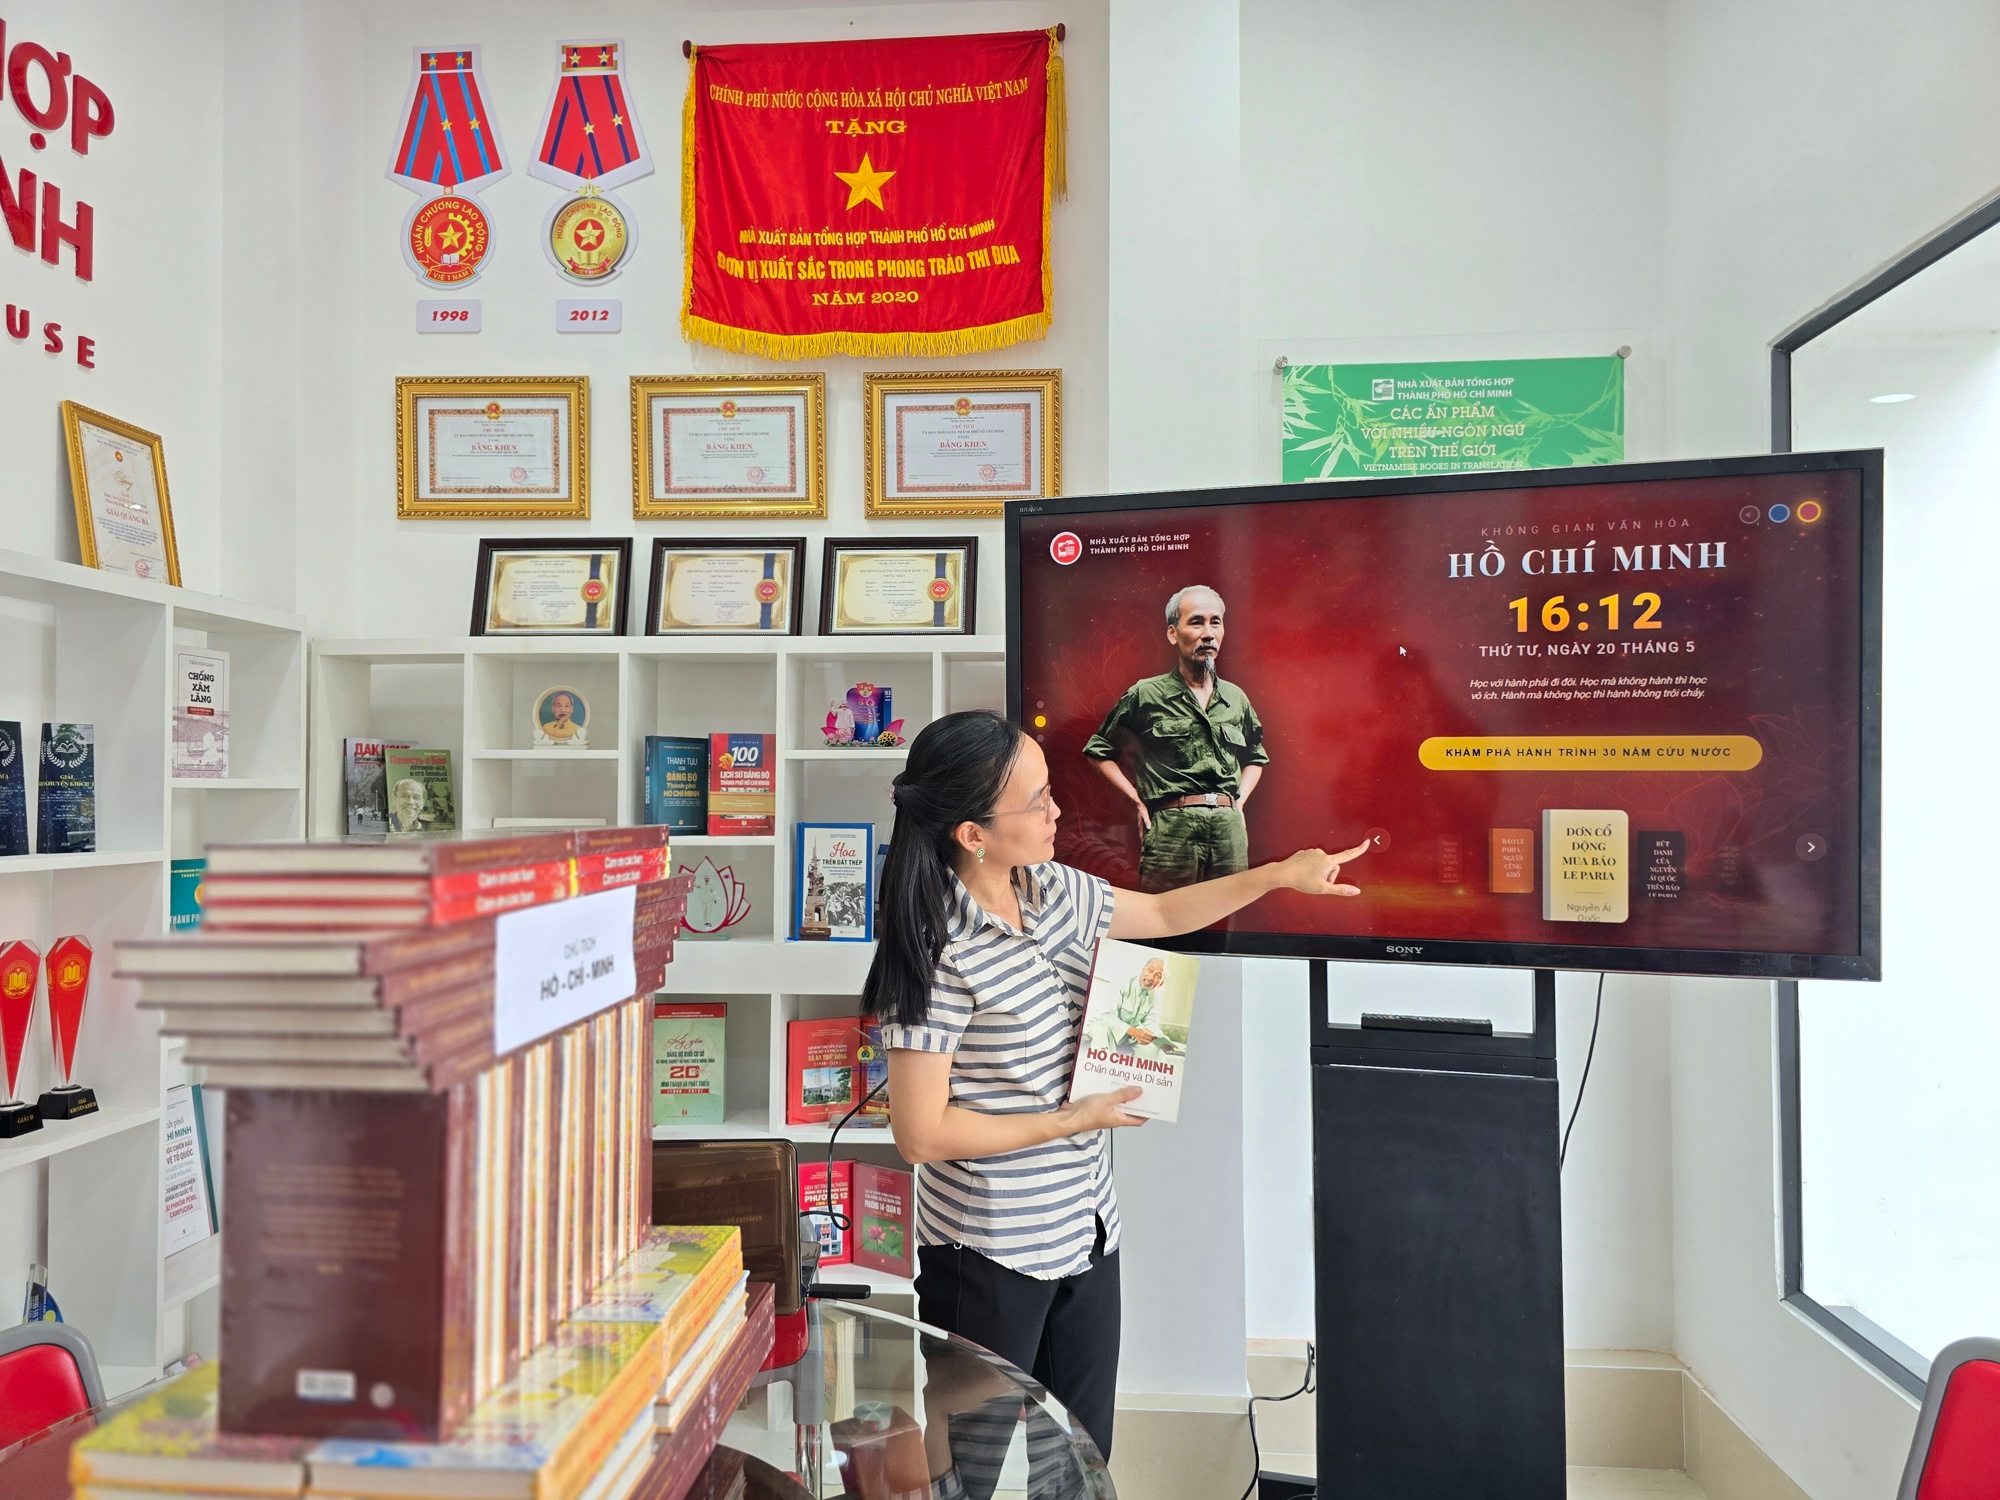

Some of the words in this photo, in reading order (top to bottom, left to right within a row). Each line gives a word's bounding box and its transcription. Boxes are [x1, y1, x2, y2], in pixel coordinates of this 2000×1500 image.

[0, 18, 115, 155] ỢP
[710, 84, 743, 105] CHÍNH
[746, 87, 769, 108] PHỦ
[772, 89, 803, 108] NƯỚC
[807, 88, 838, 112] CỘNG
[841, 87, 865, 108] HÒA
[885, 87, 906, 111] HỘI
[909, 84, 933, 106] CHỦ
[936, 83, 974, 105] NGHĨA
[975, 81, 1002, 104] VIỆT
[1005, 77, 1028, 98] NAM
[826, 118, 907, 137] TẶNG
[461, 204, 479, 220] LAO
[599, 206, 613, 216] LAO
[739, 225, 756, 244] NHÀ
[758, 227, 787, 245] XUẤT
[789, 227, 811, 245] BẢN
[814, 226, 843, 245] TỔNG
[846, 231, 867, 248] HỢP
[869, 227, 904, 244] THÀNH
[906, 223, 930, 244] PHỐ
[930, 222, 947, 242] HỒ
[948, 224, 968, 241] CHÍ
[969, 218, 995, 238] MINH
[717, 250, 744, 279] ĐƠN
[747, 260, 759, 283] VỊ
[760, 255, 794, 280] XUẤT
[797, 255, 826, 280] SẮC
[828, 259, 874, 280] TRONG
[877, 259, 926, 278] PHONG
[928, 254, 965, 276] TRÀO
[966, 248, 991, 270] THI
[991, 244, 1020, 265] ĐUA
[812, 290, 865, 306] NĂM
[871, 291, 919, 304] 2020
[432, 310, 469, 322] 1998
[569, 310, 609, 322] 2012
[1397, 379, 1416, 389] NHÀ
[1494, 377, 1514, 388] HỢP
[1397, 390, 1429, 400] THÀNH
[1469, 389, 1485, 398] CHÍ
[1487, 389, 1512, 398] MINH
[1390, 404, 1422, 420] CÁC
[1425, 403, 1448, 419] ẤN
[1451, 401, 1495, 419] PHẨM
[1361, 425, 1387, 440] VỚI
[1391, 422, 1438, 439] NHIỀU
[1441, 422, 1488, 438] NGÔN
[1491, 422, 1526, 437] NGỮ
[1389, 445, 1427, 458] TRÊN
[1431, 441, 1459, 457] THẾ
[1462, 441, 1497, 456] GIỚI
[1363, 463, 1418, 472] VIETNAMESE
[1420, 462, 1449, 470] BOOKS
[1450, 462, 1461, 470] IN
[1462, 460, 1523, 469] TRANSLATION
[1481, 525, 1539, 536] KHÔNG
[1552, 523, 1594, 533] GIAN
[1607, 520, 1641, 531] VĂN
[1655, 517, 1689, 528] HÓA
[1090, 536, 1107, 545] NHÀ
[1109, 535, 1129, 544] XUẤT
[1131, 534, 1148, 543] BẢN
[1150, 534, 1172, 542] TỔNG
[1174, 534, 1191, 542] HỢP
[1090, 545, 1117, 555] THÀNH
[1119, 544, 1136, 553] PHỐ
[1137, 543, 1150, 552] HỒ
[1151, 542, 1165, 551] CHÍ
[1167, 543, 1189, 551] MINH
[1448, 539, 1506, 578] HỒ
[1521, 539, 1596, 575] CHÍ
[1612, 541, 1727, 572] MINH
[1508, 591, 1663, 633] 16:12
[1479, 642, 1513, 657] THỨ
[1516, 643, 1542, 658] TƯ,
[1547, 640, 1592, 656] NGÀY
[1596, 643, 1616, 655] 20
[1621, 639, 1679, 654] THÁNG
[1685, 641, 1695, 653] 5
[1470, 679, 1489, 689] Học
[1490, 679, 1504, 688] với
[1504, 678, 1527, 687] hành
[1528, 677, 1549, 688] phải
[1550, 677, 1560, 687] đi
[1579, 678, 1600, 687] Học
[1600, 677, 1616, 686] mà
[1618, 676, 1647, 687] không
[1648, 676, 1673, 685] hành
[1674, 675, 1687, 685] thì
[1688, 675, 1708, 685] học
[731, 746, 759, 762] 100
[1446, 747, 1481, 756] KHÁM
[1486, 747, 1511, 756] PHÁ
[1517, 747, 1552, 756] HÀNH
[1558, 747, 1597, 756] TRÌNH
[1602, 748, 1616, 756] 30
[1622, 747, 1651, 756] NĂM
[1656, 746, 1685, 756] CỨU
[1691, 746, 1731, 756] NƯỚC
[829, 841, 857, 857] Hoa
[1562, 856, 1588, 866] MUA
[1591, 855, 1616, 866] BÁO
[1563, 871, 1578, 880] LE
[1580, 871, 1615, 881] PARIA
[1386, 946, 1423, 954] SONY
[591, 954, 614, 980] MINH
[1087, 1046, 1109, 1061] HỒ
[1109, 1052, 1134, 1067] CHÍ
[1136, 1058, 1174, 1075] MINH
[1084, 1062, 1107, 1075] Chân
[1109, 1067, 1130, 1082] dung
[1132, 1071, 1143, 1082] và
[1145, 1074, 1155, 1084] Di
[1156, 1075, 1173, 1087] sản
